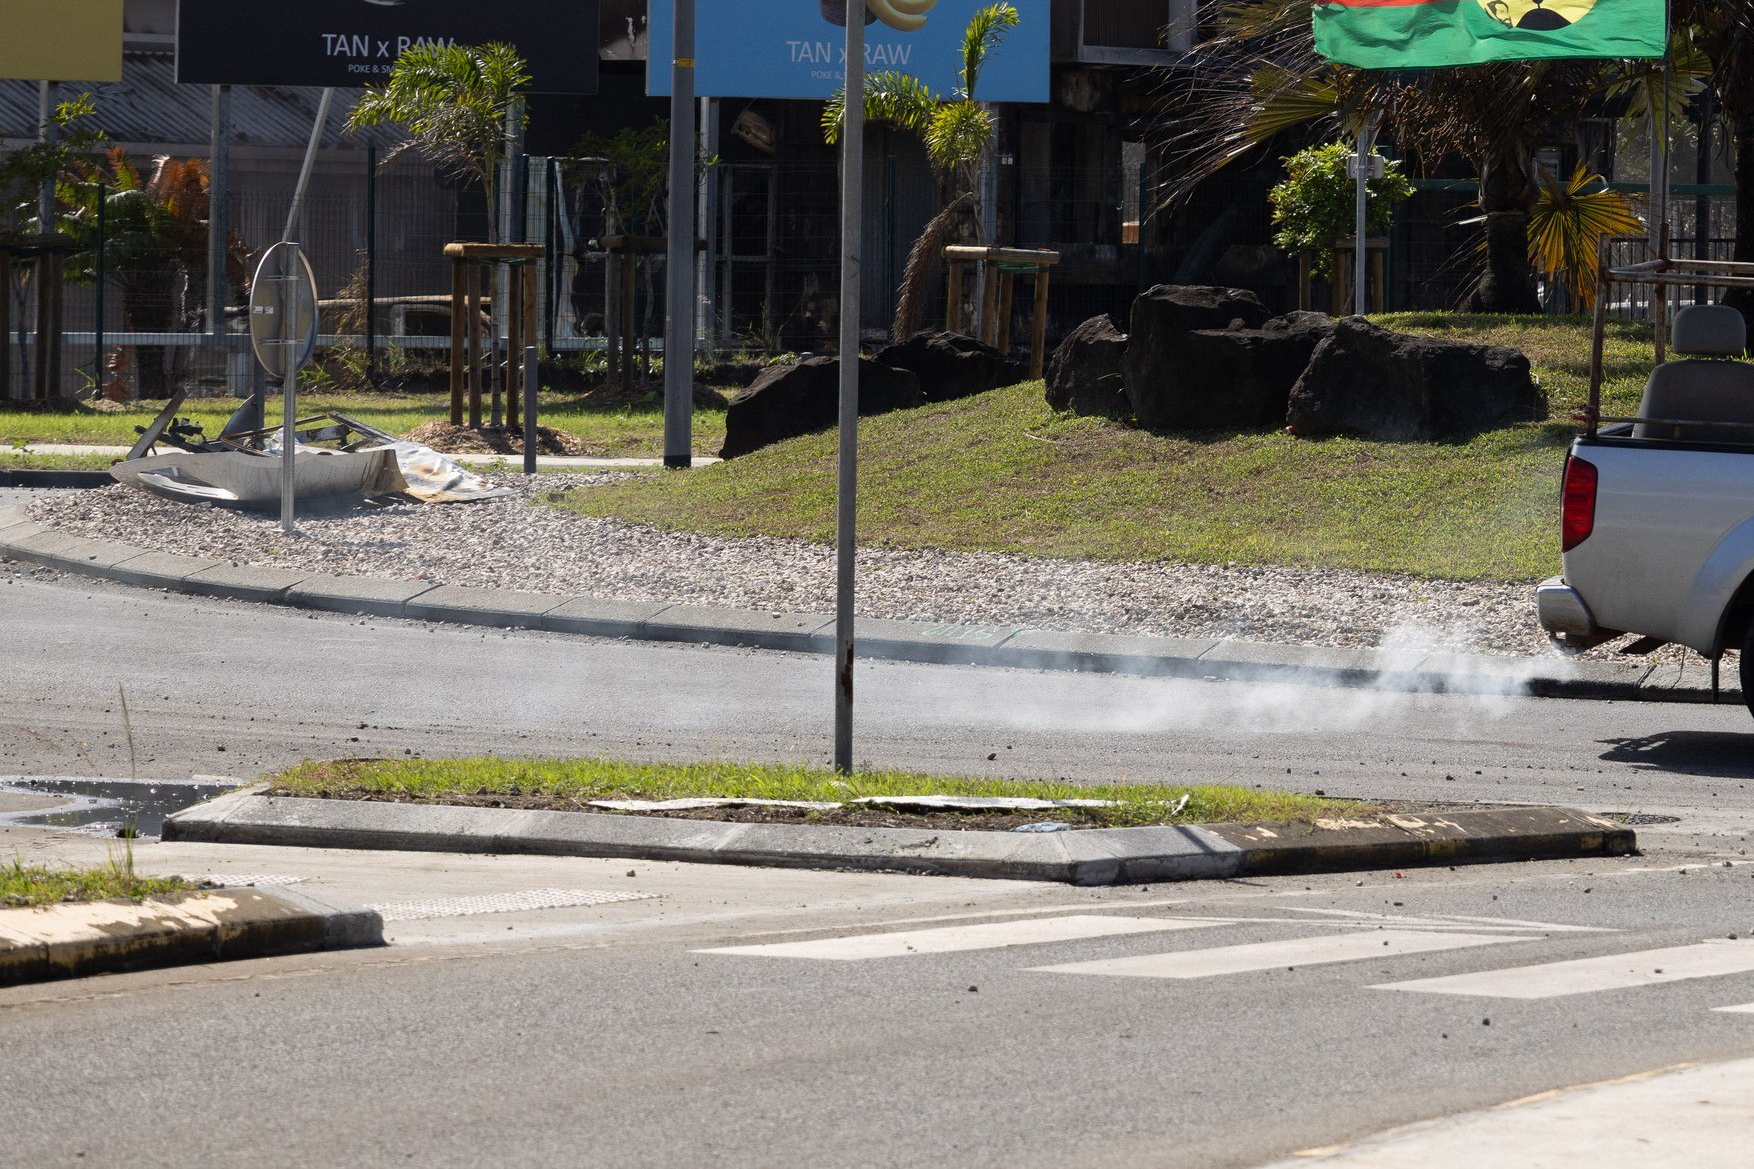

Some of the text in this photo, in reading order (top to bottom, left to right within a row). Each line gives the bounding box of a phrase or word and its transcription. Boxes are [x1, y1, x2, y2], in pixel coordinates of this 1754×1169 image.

[321, 33, 369, 57] TAN
[786, 40, 831, 64] TAN
[348, 64, 371, 73] POKE
[372, 64, 379, 73] &
[811, 70, 832, 79] POKE
